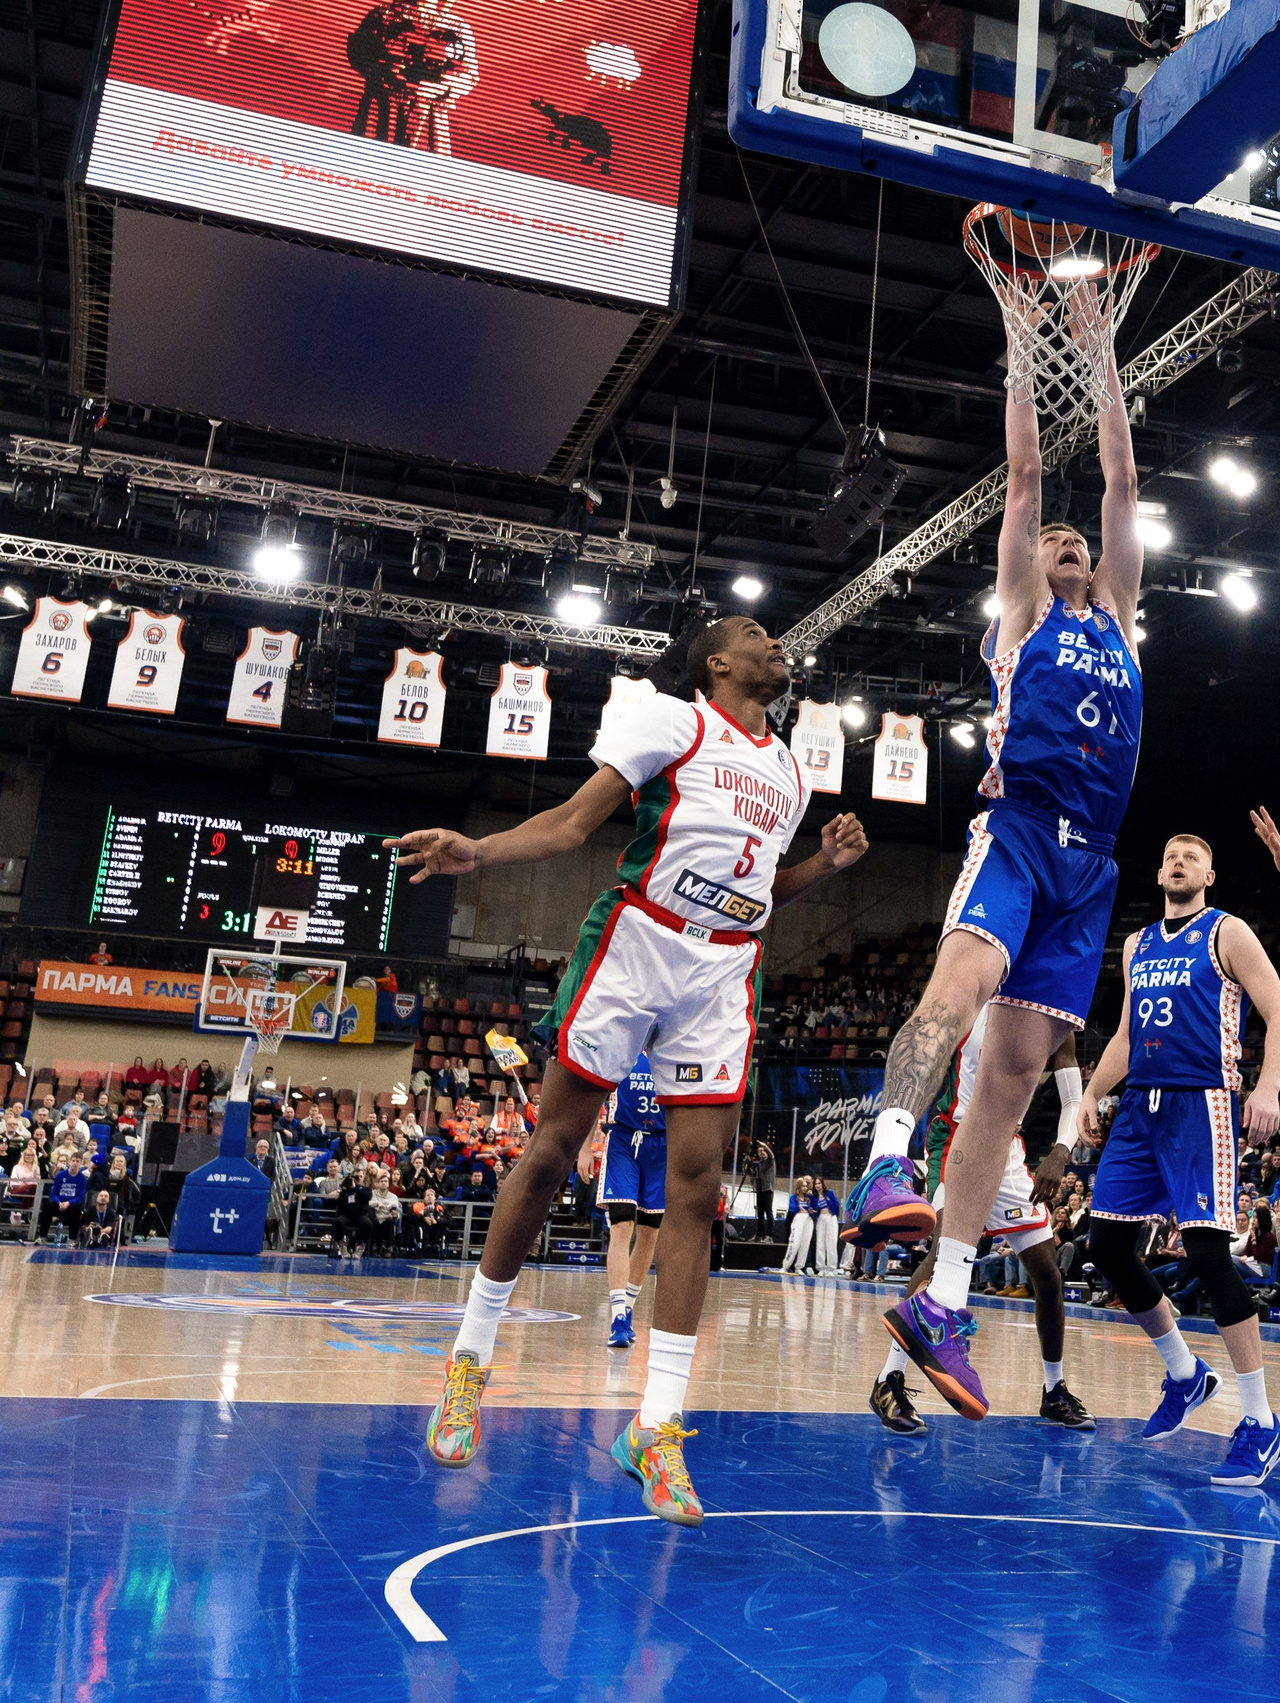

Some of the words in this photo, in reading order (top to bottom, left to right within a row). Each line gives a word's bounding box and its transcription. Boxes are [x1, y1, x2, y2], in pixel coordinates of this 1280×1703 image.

[152, 129, 274, 171] Давайте
[281, 159, 418, 203] умножать
[423, 194, 525, 226] любовь
[531, 217, 626, 248] вместе!
[35, 633, 78, 651] ЗАХАРОВ
[41, 652, 64, 675] 6
[135, 647, 167, 664] БЕЛЫХ
[135, 665, 158, 688] 9
[252, 680, 273, 703] 4
[401, 683, 429, 699] БЕЛОВ
[393, 700, 429, 724] 10
[498, 697, 544, 713] БАШМИНОВ
[503, 713, 535, 736] 15
[801, 732, 836, 748] ПЕГУШИН
[804, 748, 831, 772] 13
[885, 744, 919, 760] ДАЙНЕКО
[886, 759, 915, 783] 15
[714, 767, 792, 820] LOKOMOTIV
[157, 811, 204, 828] BETCITY
[205, 816, 243, 832] PARMA
[733, 794, 780, 835] KUBAN
[210, 832, 226, 856] 9
[264, 823, 328, 840] LOKOMOTIV
[329, 831, 366, 845] KUBAN
[251, 844, 257, 855] 1
[733, 835, 762, 879] 5
[276, 857, 313, 876] 3:11
[199, 904, 210, 919] 3
[221, 910, 257, 933] 3:1
[686, 925, 707, 940] BCLK
[1131, 957, 1197, 976] BETCITY
[42, 970, 134, 997] ПАРМА
[143, 980, 201, 1000] FANS
[1130, 970, 1191, 993] PARMA
[1138, 996, 1173, 1029] 93
[637, 1096, 660, 1114] 35
